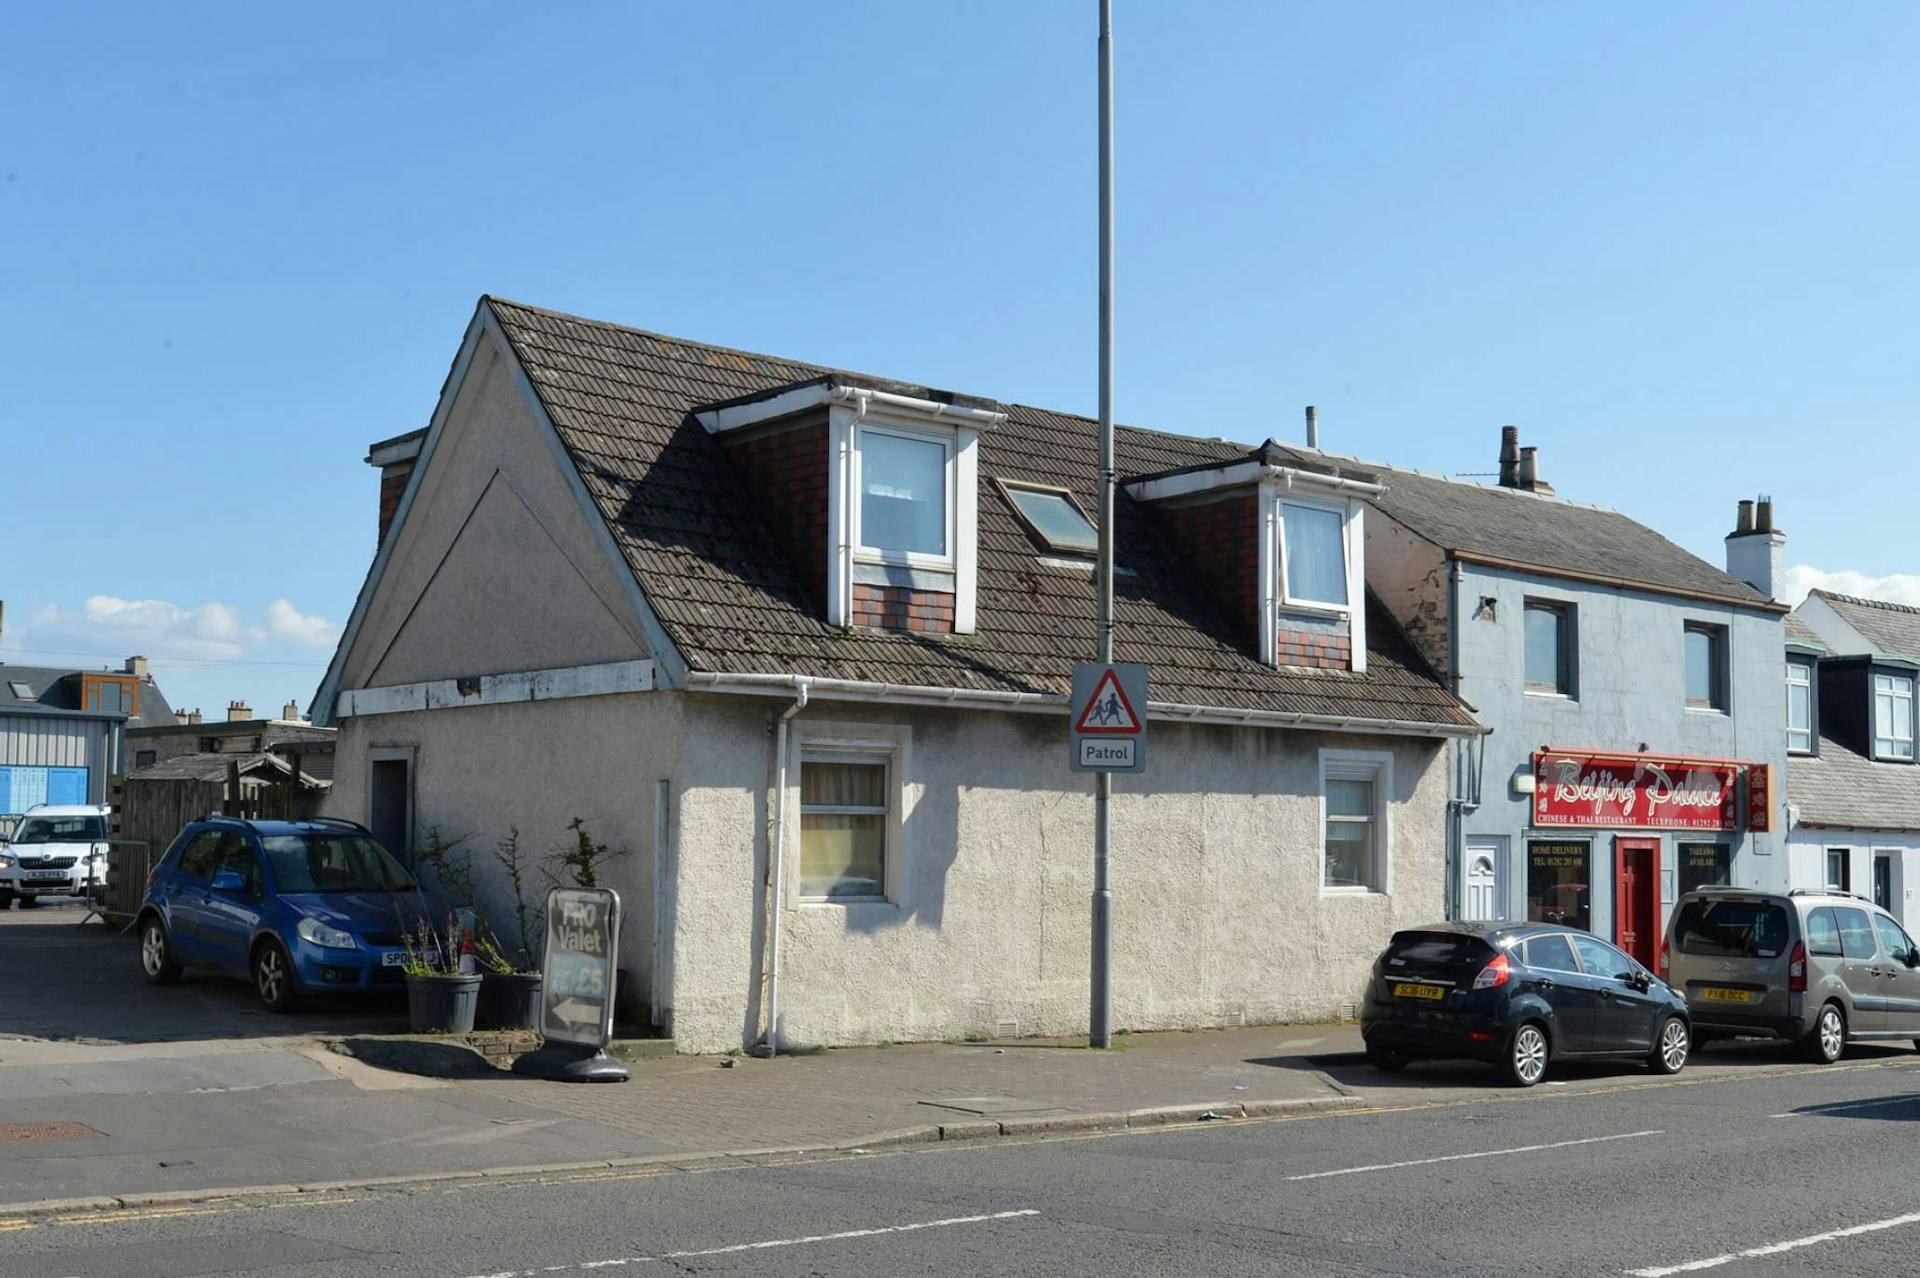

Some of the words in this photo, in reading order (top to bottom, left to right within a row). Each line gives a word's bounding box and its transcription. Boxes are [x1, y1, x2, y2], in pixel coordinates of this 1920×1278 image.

[1086, 746, 1128, 760] Patrol
[1554, 758, 1636, 816] Beijing
[1645, 762, 1722, 817] Palace
[1538, 814, 1568, 824] CHINESE
[1577, 816, 1593, 825] THAI
[1595, 816, 1637, 826] RESTAURANT
[1532, 846, 1551, 855] HOME
[1552, 846, 1583, 855] DELIVERY
[563, 901, 597, 928] PRO
[558, 924, 603, 953] Valet
[386, 952, 411, 964] SP0
